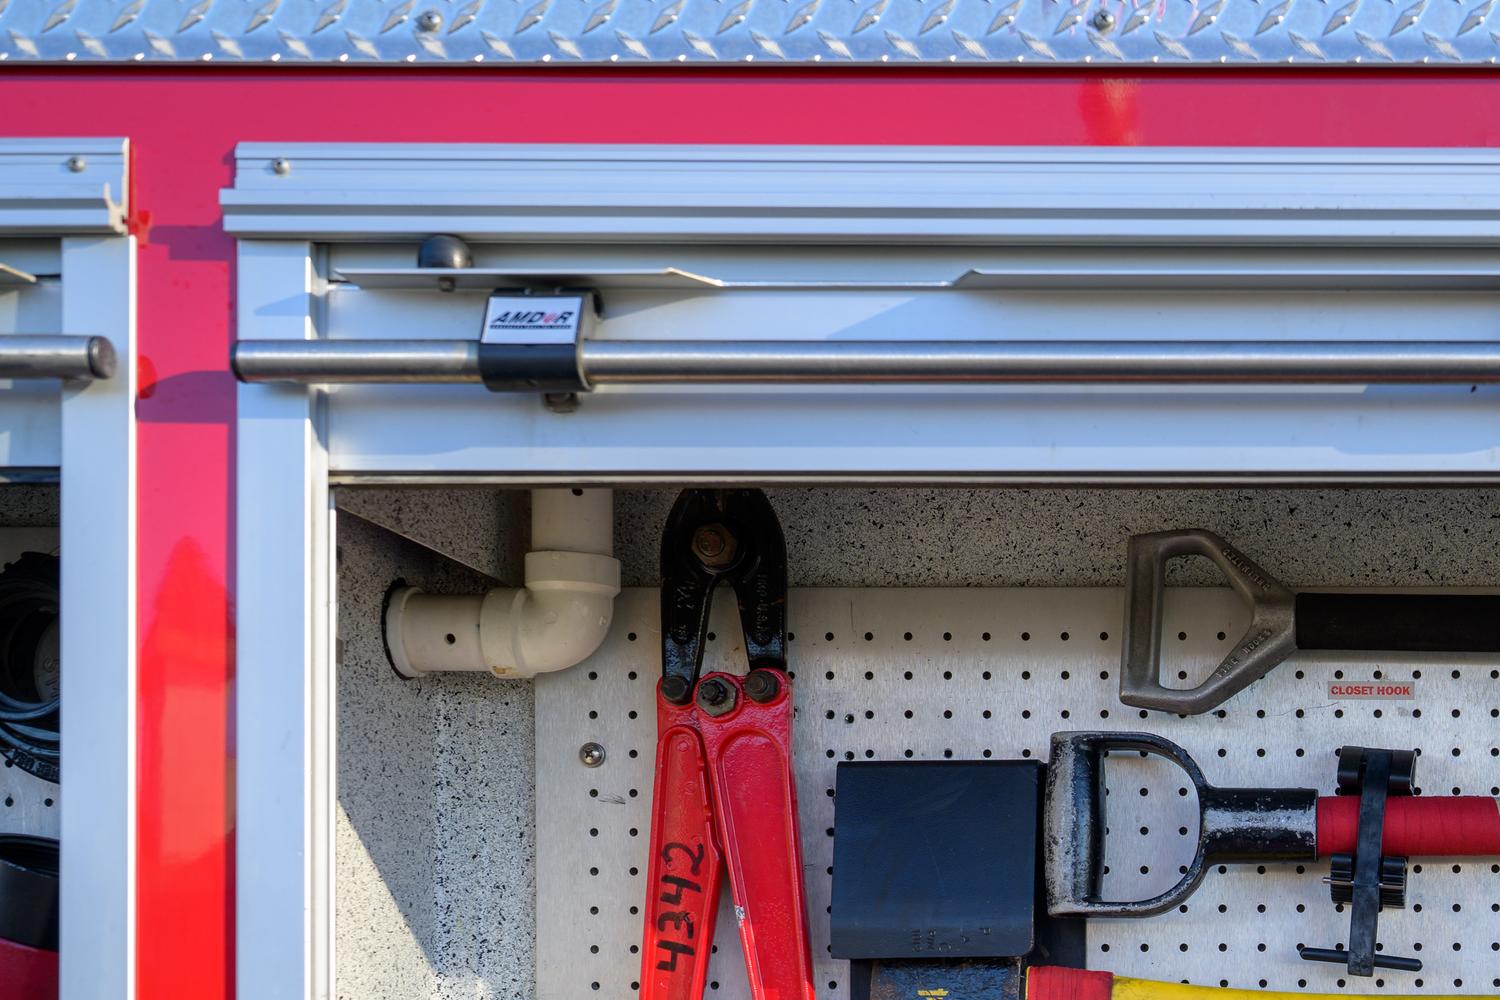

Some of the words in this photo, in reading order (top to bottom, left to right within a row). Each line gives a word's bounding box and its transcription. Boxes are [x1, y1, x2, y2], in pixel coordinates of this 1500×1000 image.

[491, 311, 575, 324] AMDOR
[1331, 686, 1374, 695] CLOSET
[1377, 686, 1410, 695] HOOK
[656, 842, 705, 972] 4342
